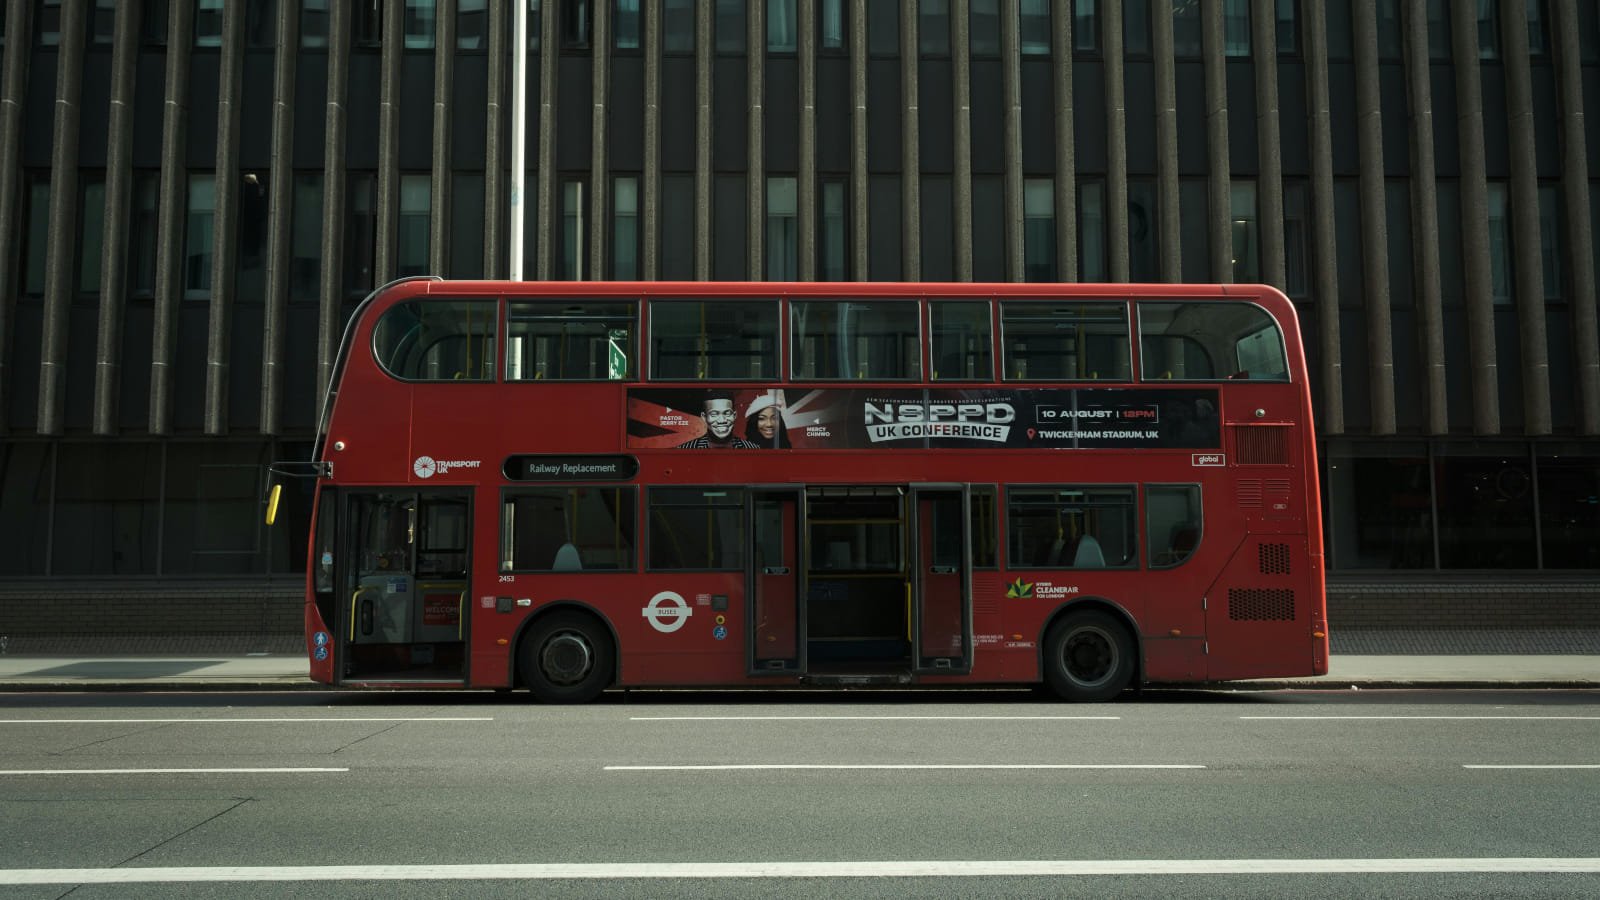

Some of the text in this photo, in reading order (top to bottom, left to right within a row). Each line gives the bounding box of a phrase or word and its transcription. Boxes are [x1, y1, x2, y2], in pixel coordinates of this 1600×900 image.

[864, 402, 1015, 424] NSPPD
[876, 424, 1001, 438] UK CONFERENCE
[1102, 431, 1144, 440] STADIUM,
[1199, 455, 1218, 465] global
[530, 463, 616, 475] Railway Replacement
